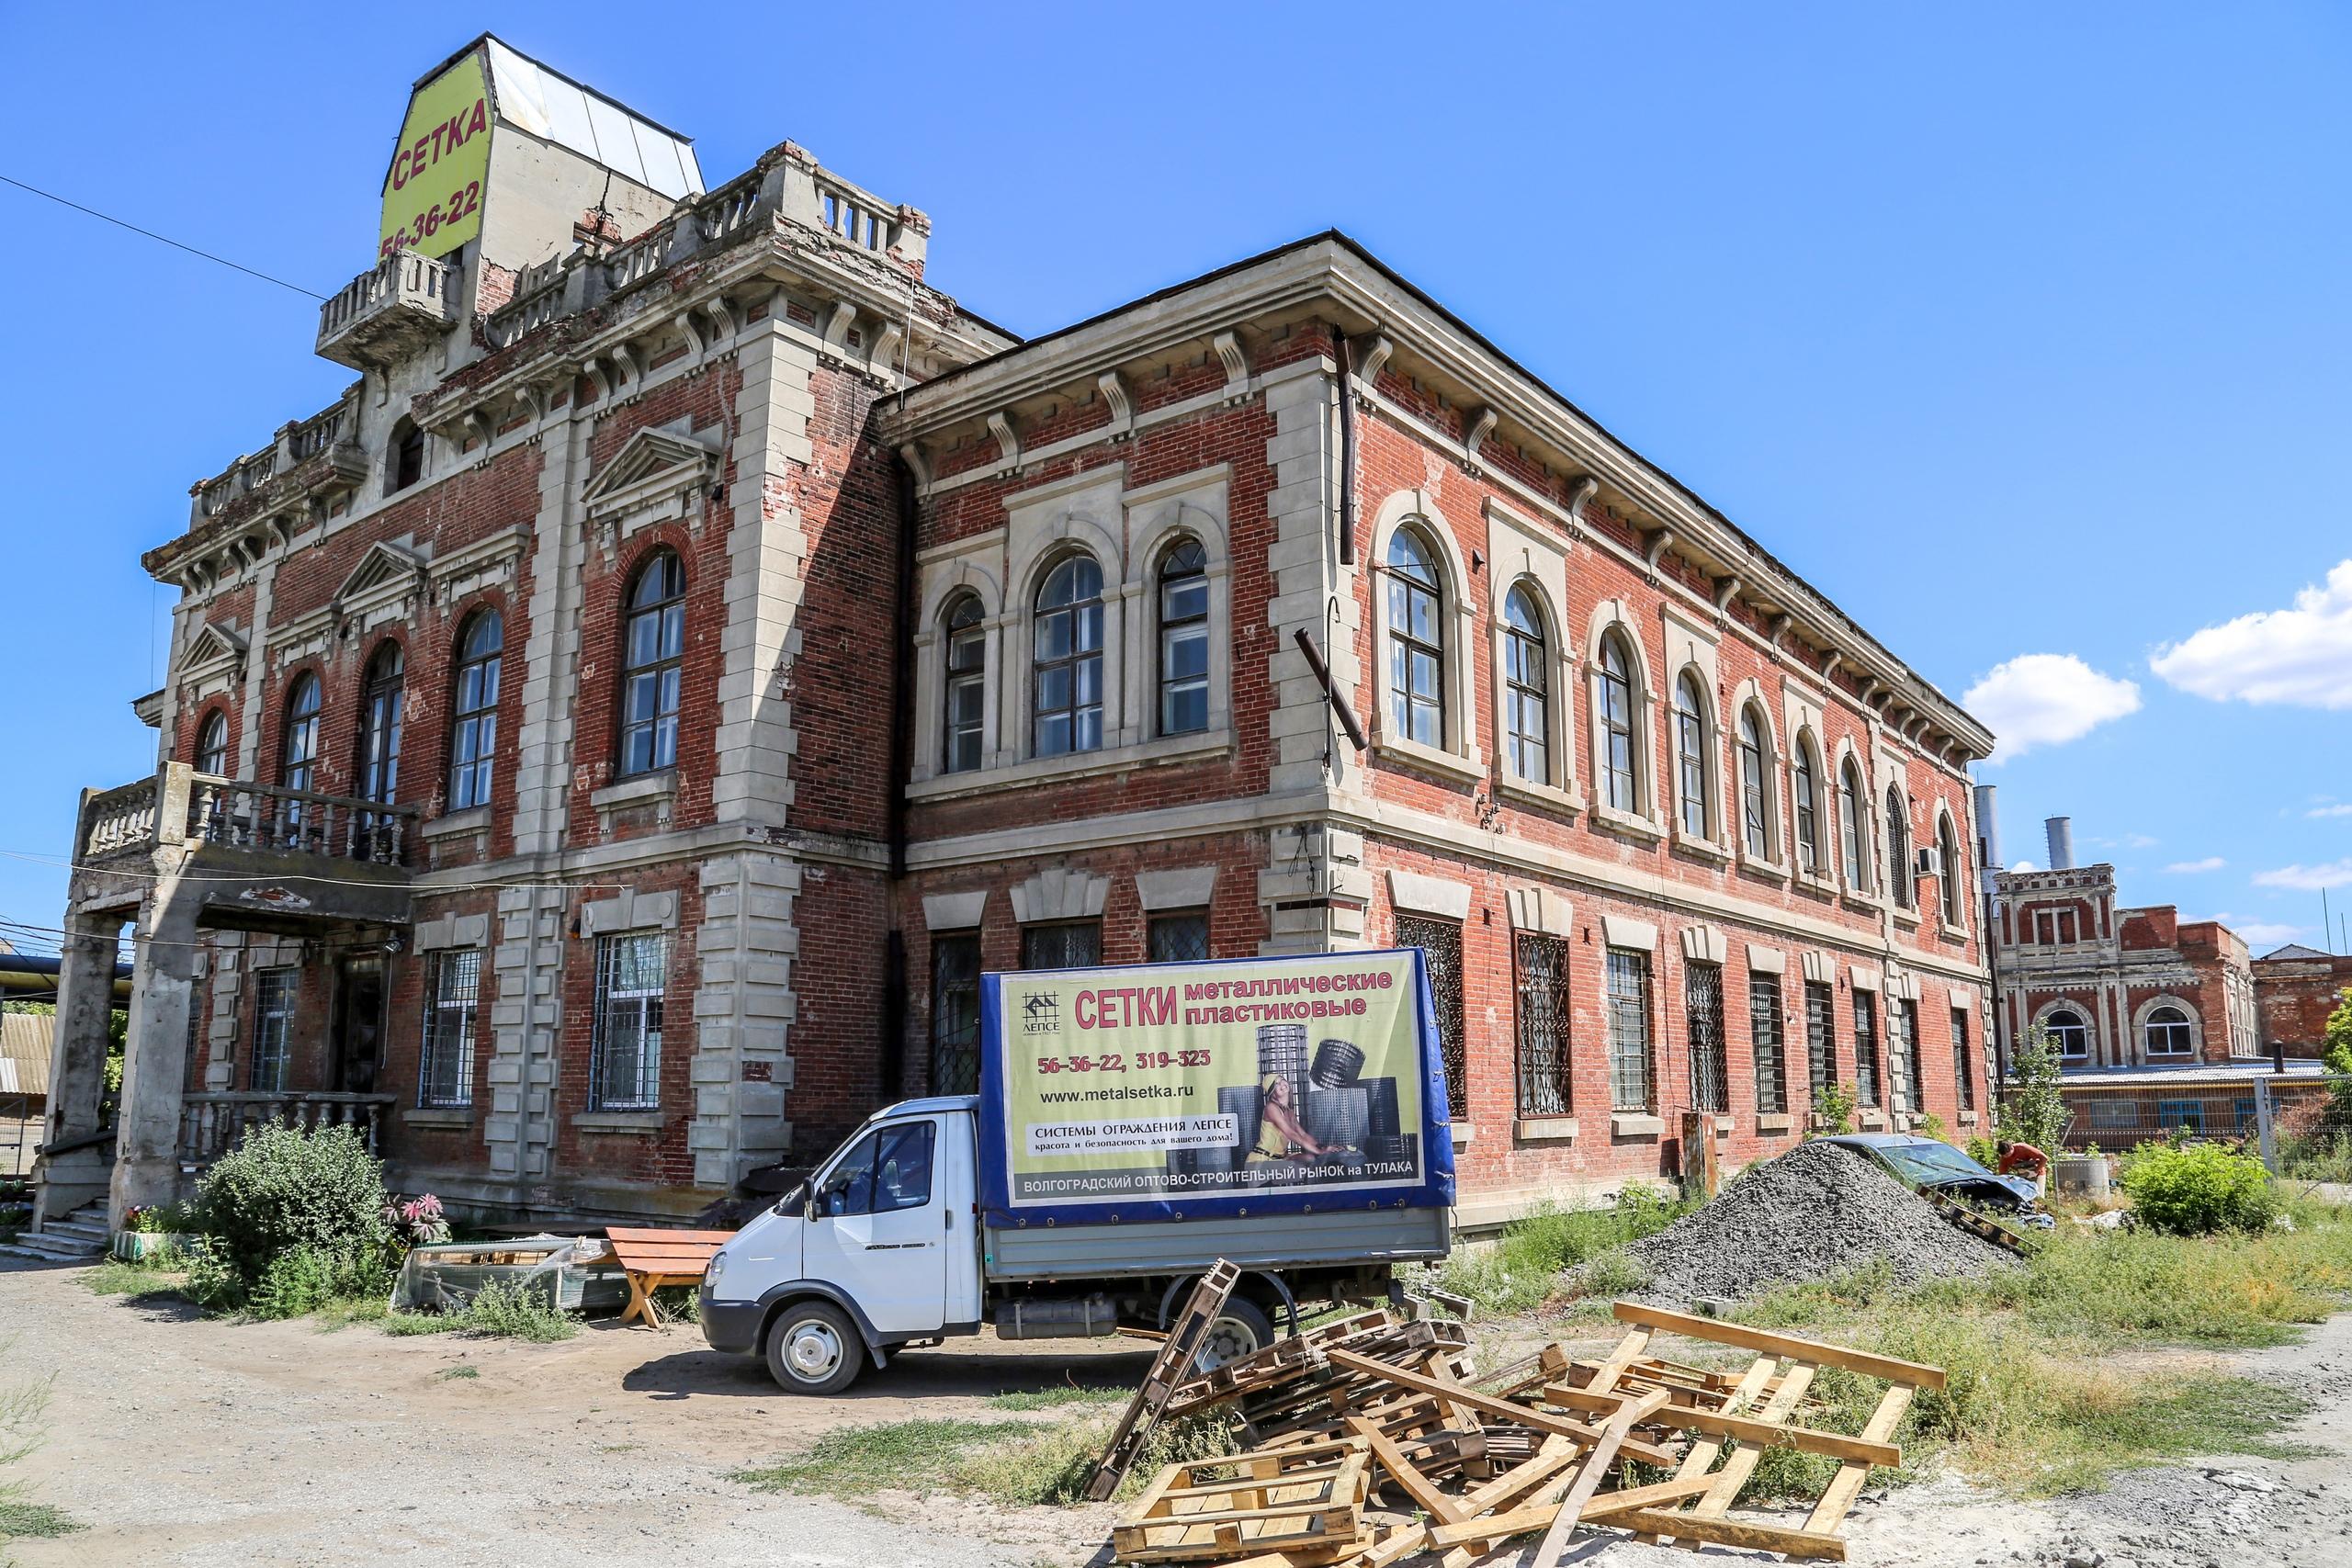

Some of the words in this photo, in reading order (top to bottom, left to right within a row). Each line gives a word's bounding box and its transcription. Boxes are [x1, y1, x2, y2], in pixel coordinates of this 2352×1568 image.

[393, 97, 486, 190] СЕТКА
[1184, 972, 1393, 1000] металлические
[1075, 986, 1178, 1030] СЕТКИ
[1185, 998, 1367, 1025] пластиковые
[1023, 1021, 1060, 1032] ЛЕПСЕ
[1038, 1054, 1126, 1074] 56-36-22,
[1136, 1050, 1211, 1069] 319-323
[1041, 1085, 1194, 1103] www.metalsetka.ru
[1035, 1125, 1096, 1138] СИСТЕМЫ
[1102, 1122, 1186, 1135] ОГРАЖДЕНИЯ
[1193, 1119, 1232, 1131] ЛЕПСЕ
[1035, 1142, 1070, 1151] красота
[1085, 1139, 1147, 1148] безопасность
[1170, 1135, 1202, 1145] вашего
[1206, 1133, 1233, 1142] дома!
[1024, 1174, 1131, 1192] ВОЛГОГРАДСКИЙ
[1135, 1166, 1295, 1187] ОПТОВО-СТРОИТЕЛЬНЫЙ
[1299, 1165, 1344, 1179] РЫНОК
[1348, 1167, 1362, 1176] на
[1364, 1161, 1413, 1174] ТУЛАКА
